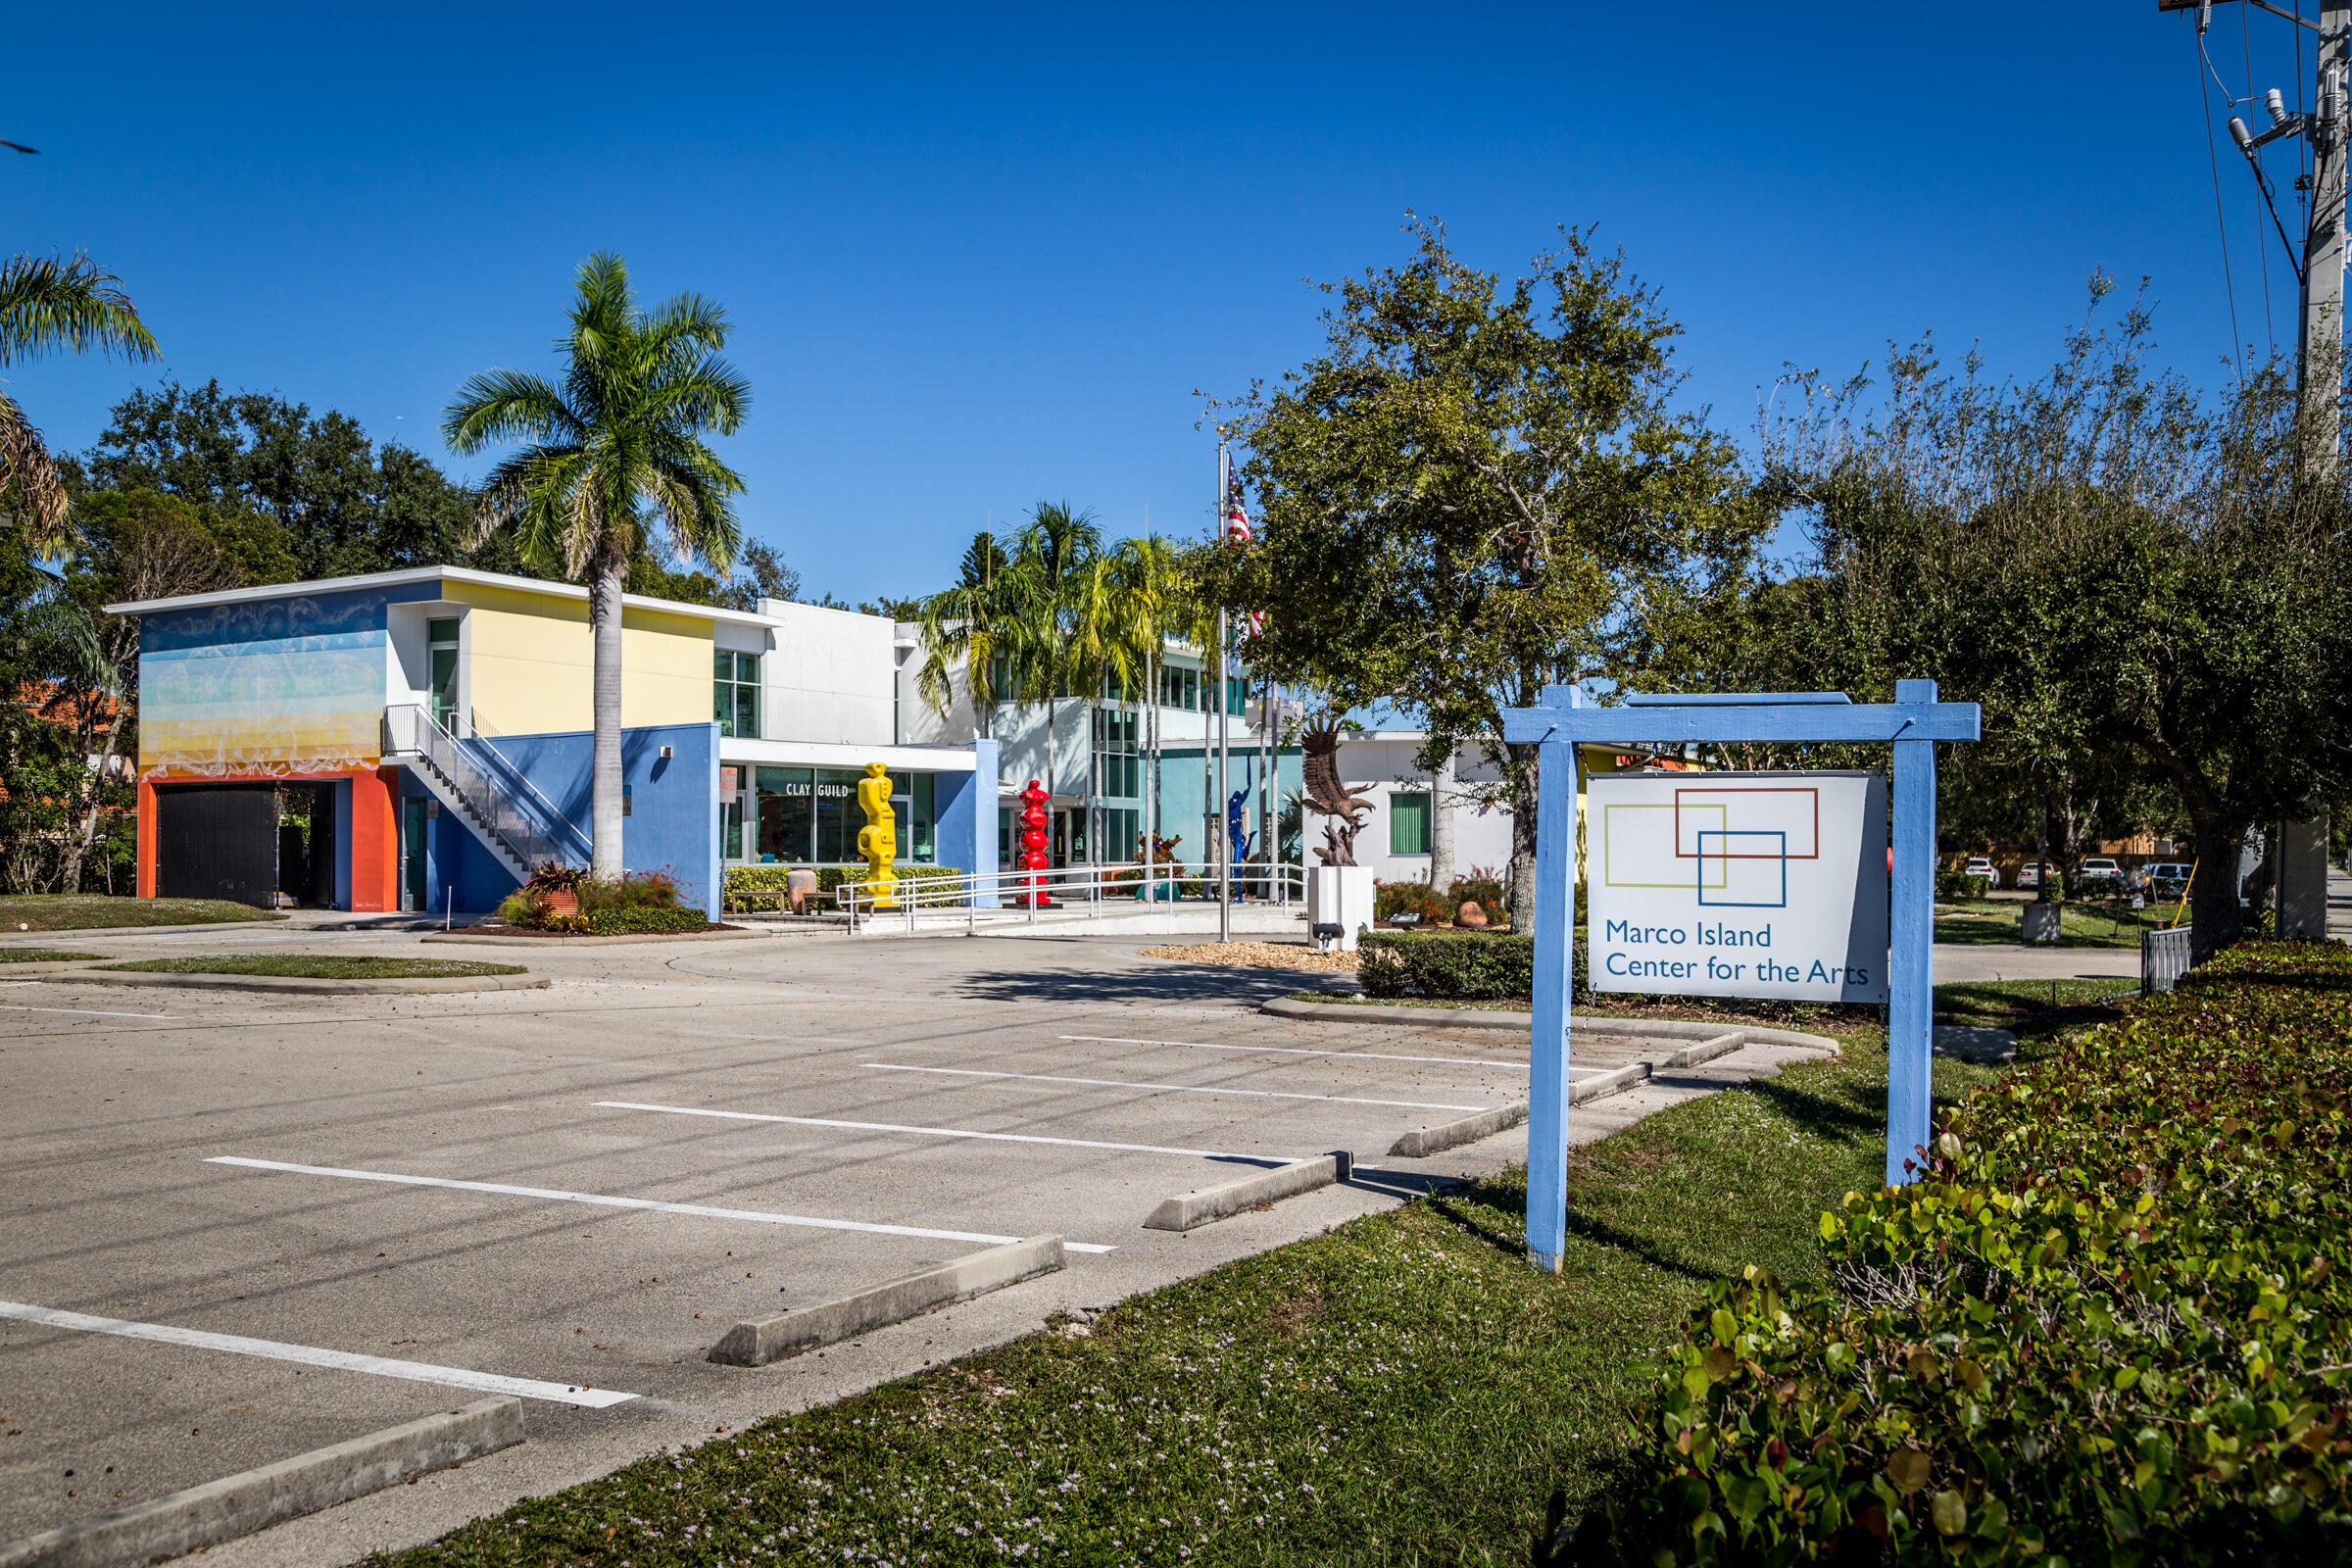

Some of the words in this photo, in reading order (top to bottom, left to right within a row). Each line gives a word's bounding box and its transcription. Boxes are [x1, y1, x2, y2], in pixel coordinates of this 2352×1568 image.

[786, 783, 810, 796] CLAY
[817, 784, 849, 797] GUILD
[1606, 919, 1687, 945] Marco
[1697, 921, 1772, 948] Island
[1606, 953, 1698, 979] Center
[1707, 956, 1746, 981] for
[1756, 957, 1800, 983] the
[1807, 959, 1869, 986] Arts
